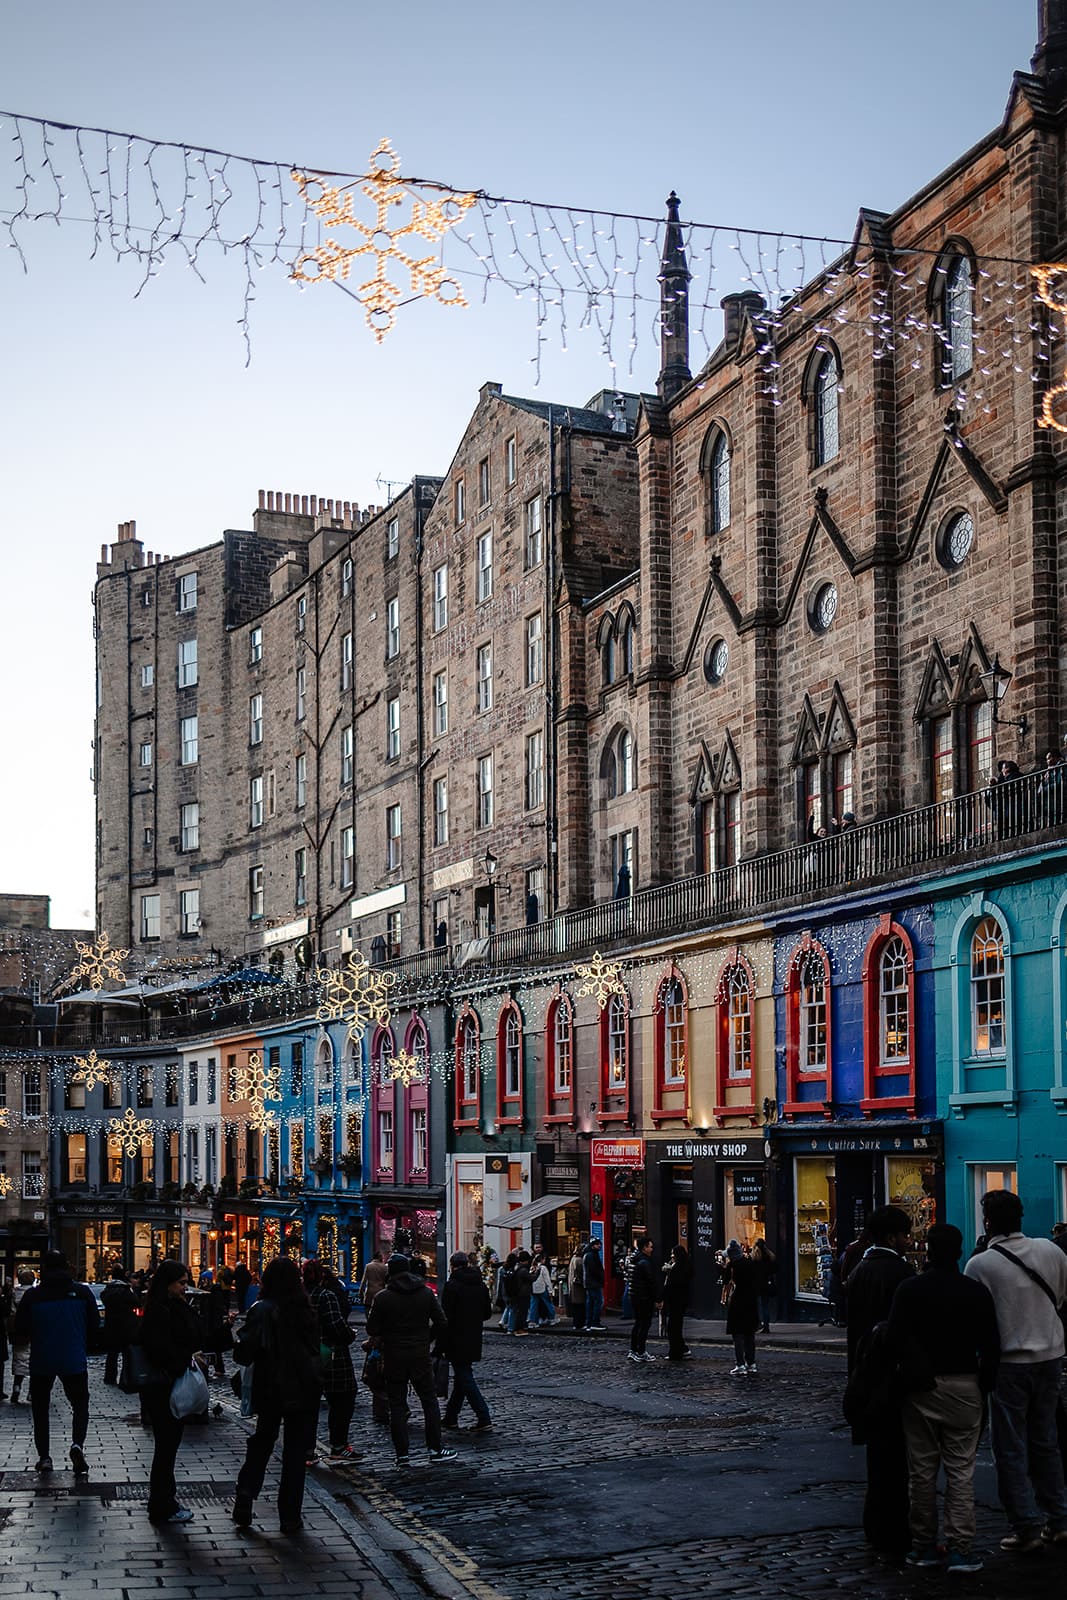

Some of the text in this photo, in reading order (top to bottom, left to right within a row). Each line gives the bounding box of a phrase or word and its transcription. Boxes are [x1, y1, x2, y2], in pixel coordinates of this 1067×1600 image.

[666, 1144, 748, 1156] THE WHISKY SHOP
[859, 1139, 881, 1150] Sark
[604, 1145, 625, 1156] ELEPHANT
[625, 1145, 640, 1156] HOUSE
